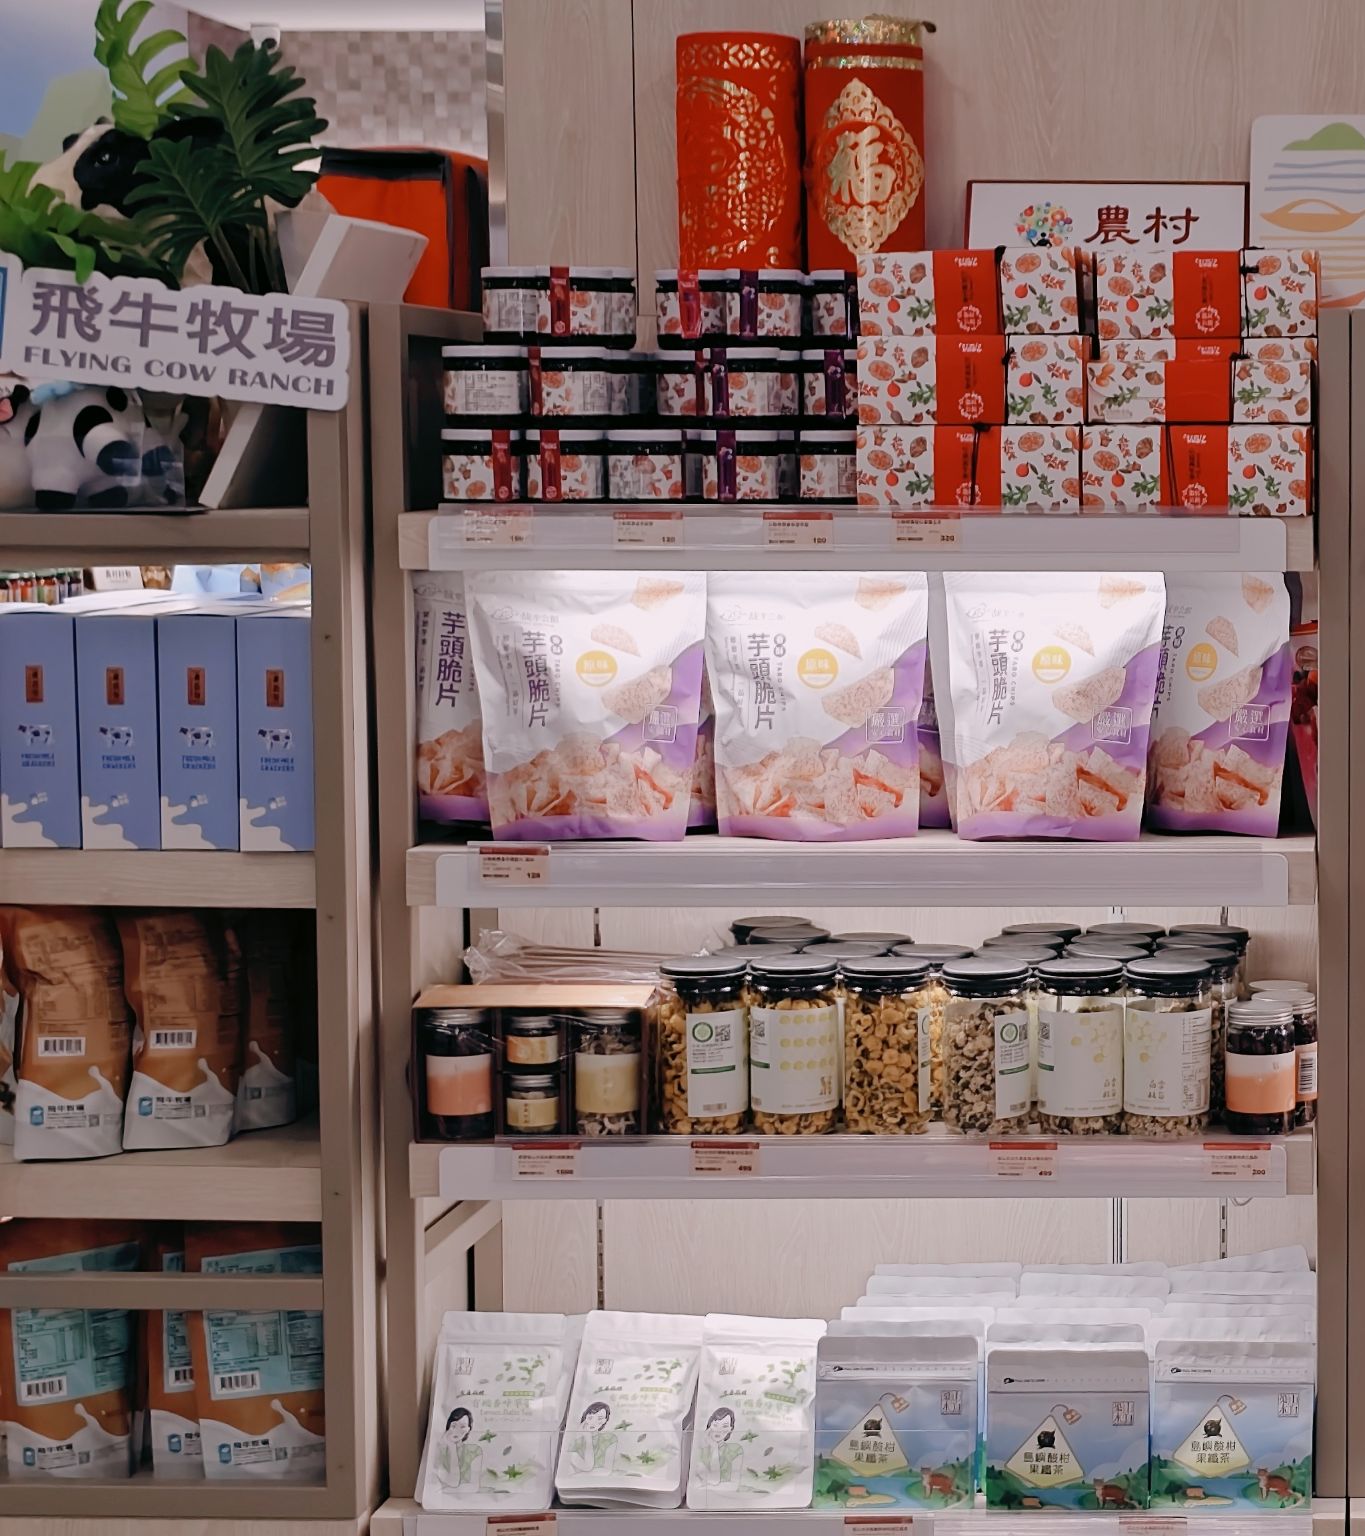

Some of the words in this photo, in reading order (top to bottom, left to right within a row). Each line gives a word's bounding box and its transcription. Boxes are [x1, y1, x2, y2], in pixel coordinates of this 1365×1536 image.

[827, 125, 896, 204] 福
[1084, 205, 1200, 245] 農村
[30, 281, 336, 368] 飛牛牧場
[24, 346, 131, 374] FLYING
[144, 359, 217, 382] COW
[228, 368, 335, 396] RANCH
[435, 611, 466, 707] 芋頭脆片
[521, 630, 550, 728] 芋頭脆片
[747, 632, 777, 731] 芋頭脆片
[986, 629, 1010, 725] 芋頭脆片
